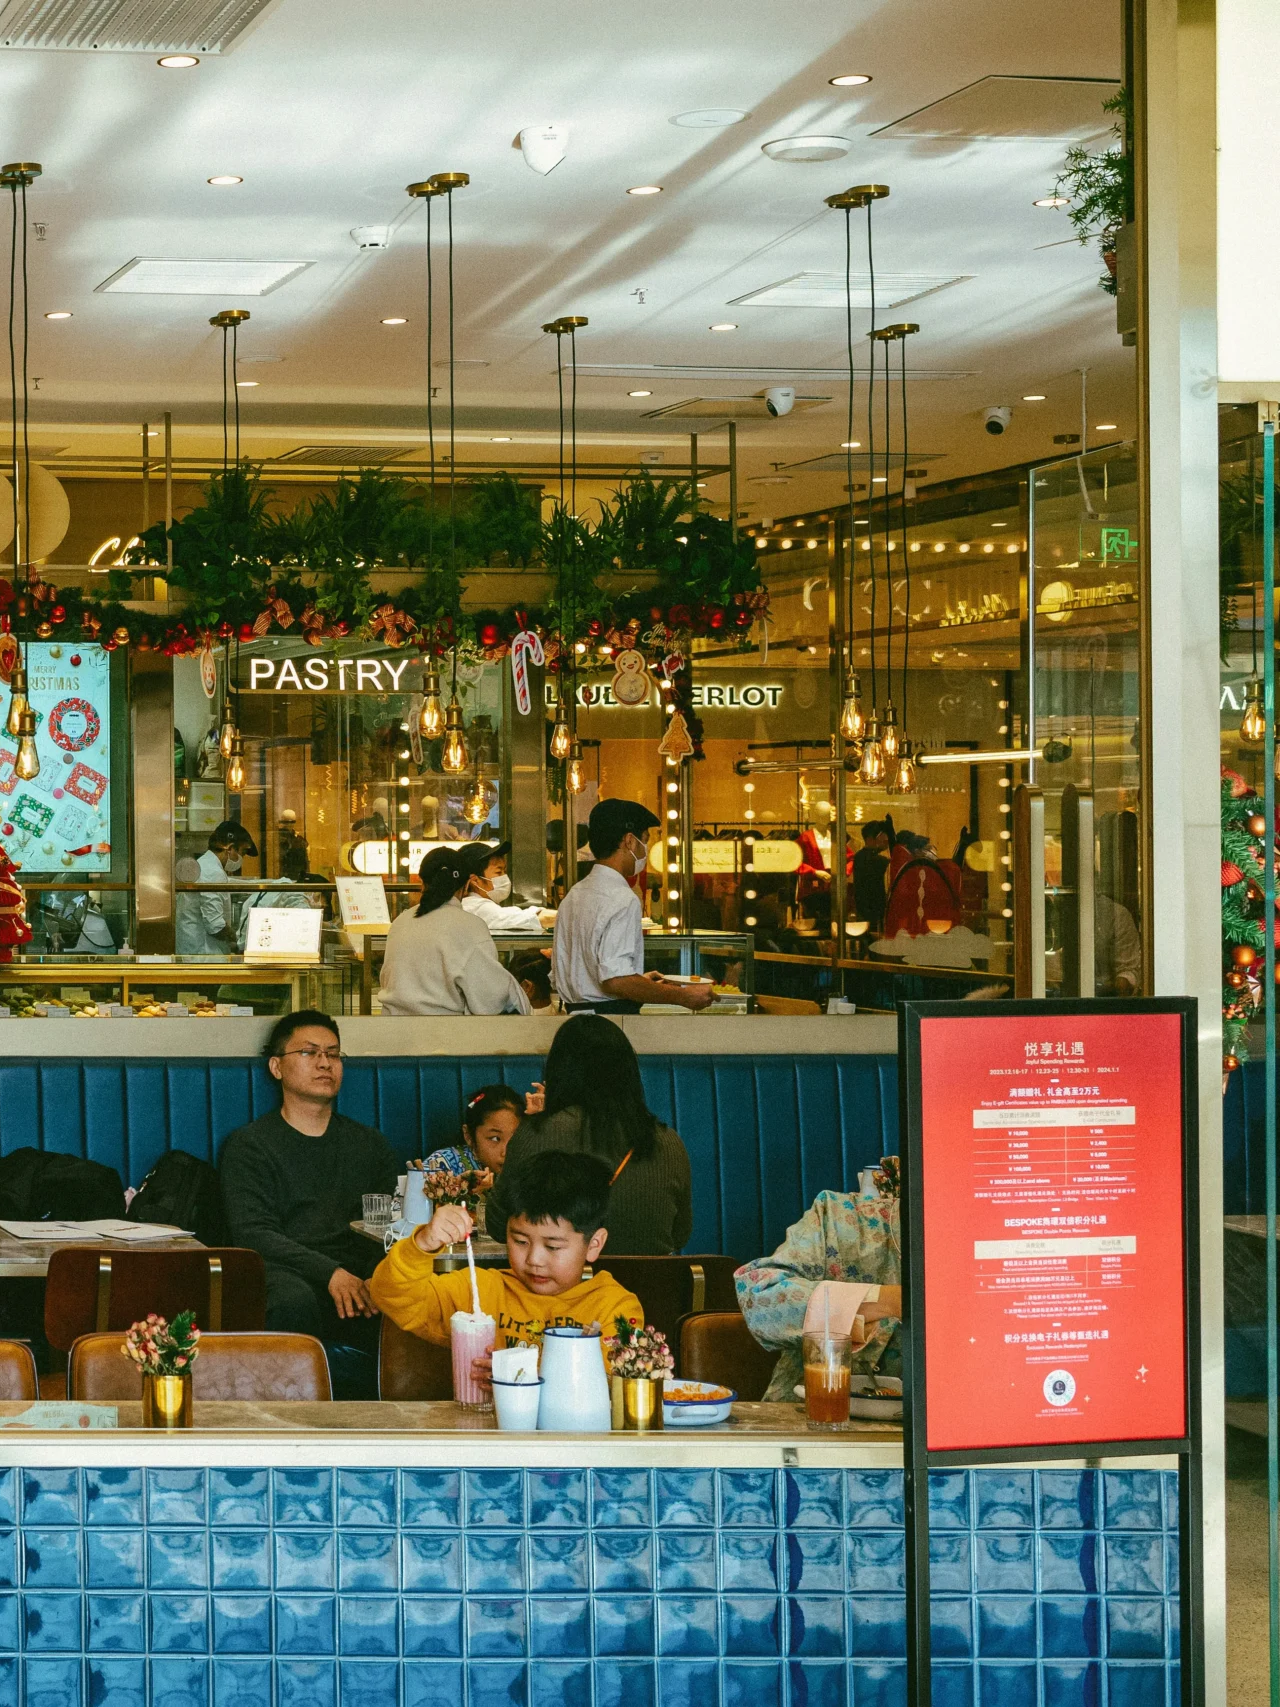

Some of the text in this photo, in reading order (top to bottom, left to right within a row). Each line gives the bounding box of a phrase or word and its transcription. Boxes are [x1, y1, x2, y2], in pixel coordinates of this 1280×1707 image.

[28, 676, 80, 690] RISTMAS
[250, 658, 409, 691] PASTRY
[658, 686, 782, 706] ERLOT
[1024, 1041, 1085, 1057] 悦享礼遇
